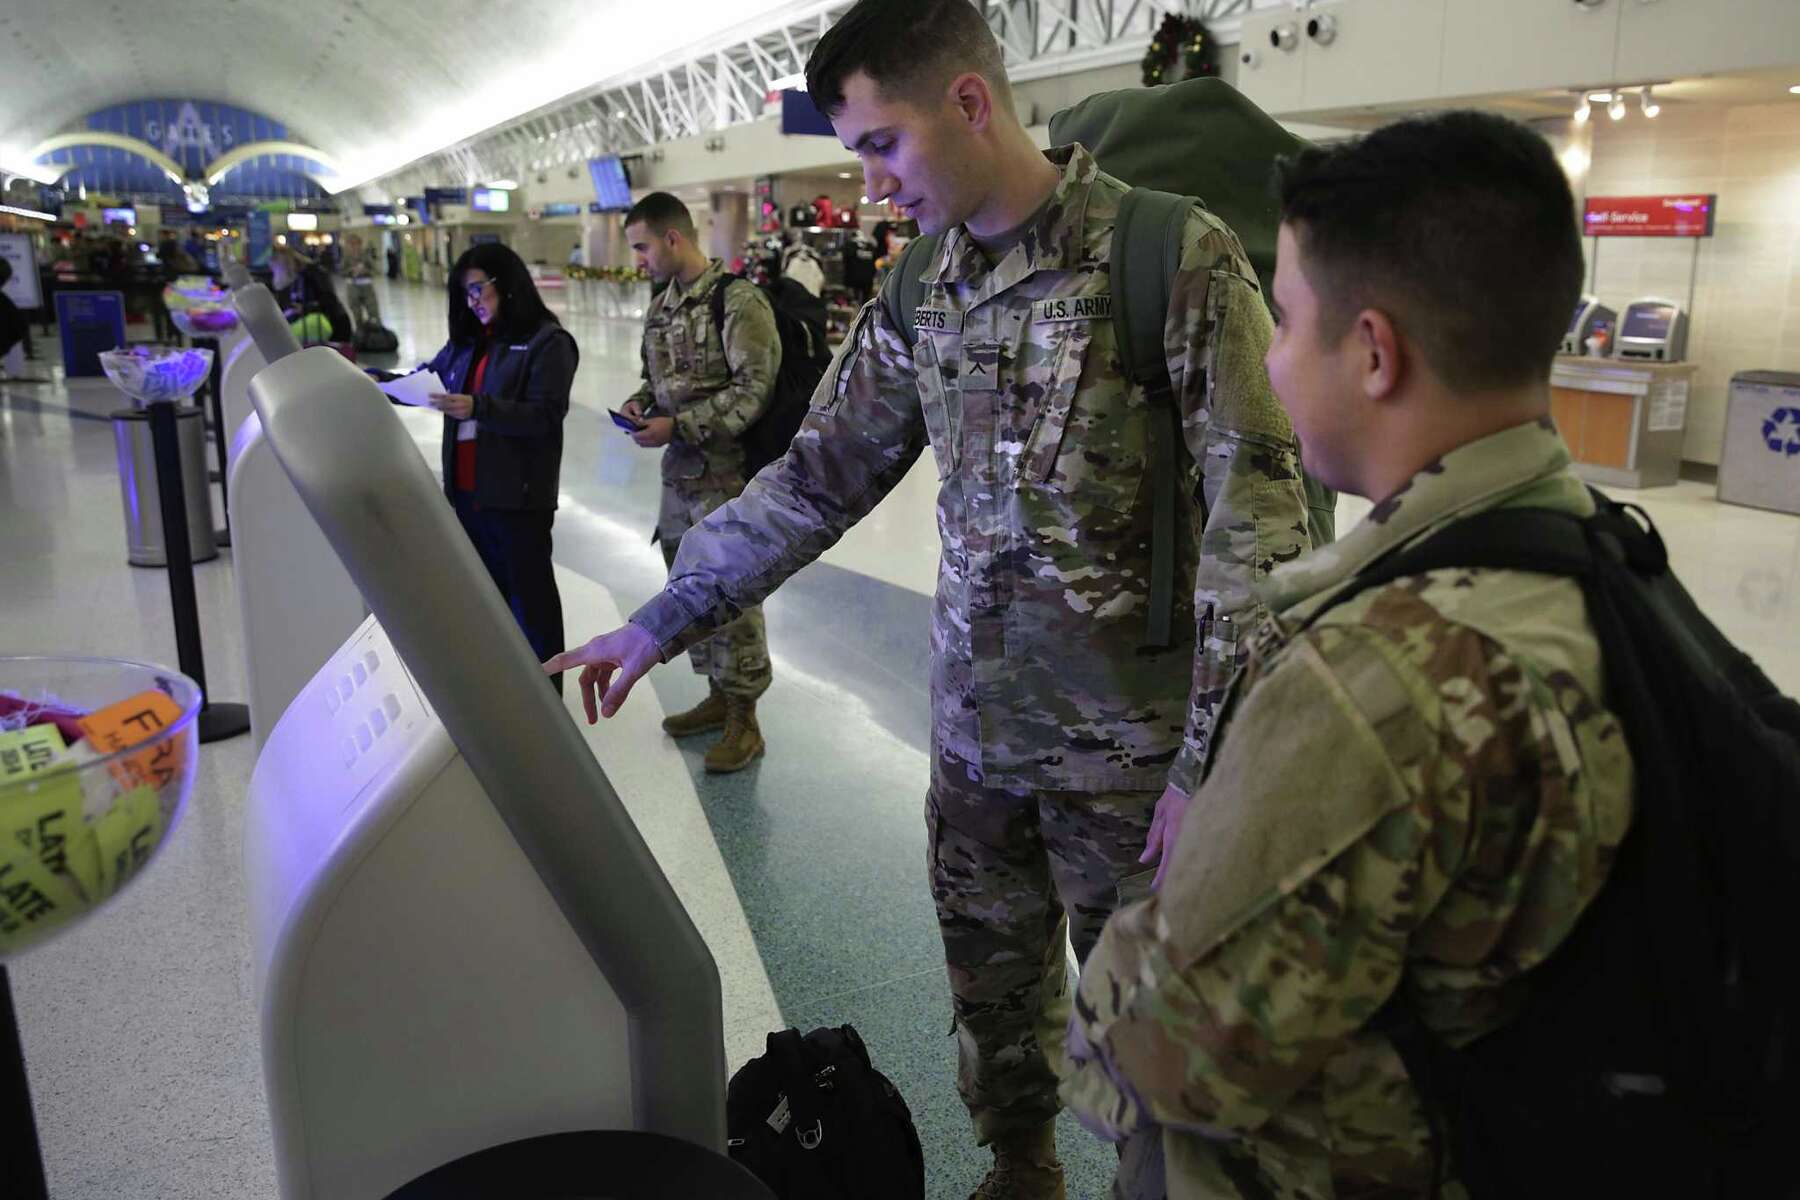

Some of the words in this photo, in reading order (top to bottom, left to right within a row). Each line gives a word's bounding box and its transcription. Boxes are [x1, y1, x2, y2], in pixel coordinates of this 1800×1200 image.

[1044, 301, 1069, 319] U.S.
[1074, 297, 1112, 317] ARMY
[915, 310, 945, 329] BERTS
